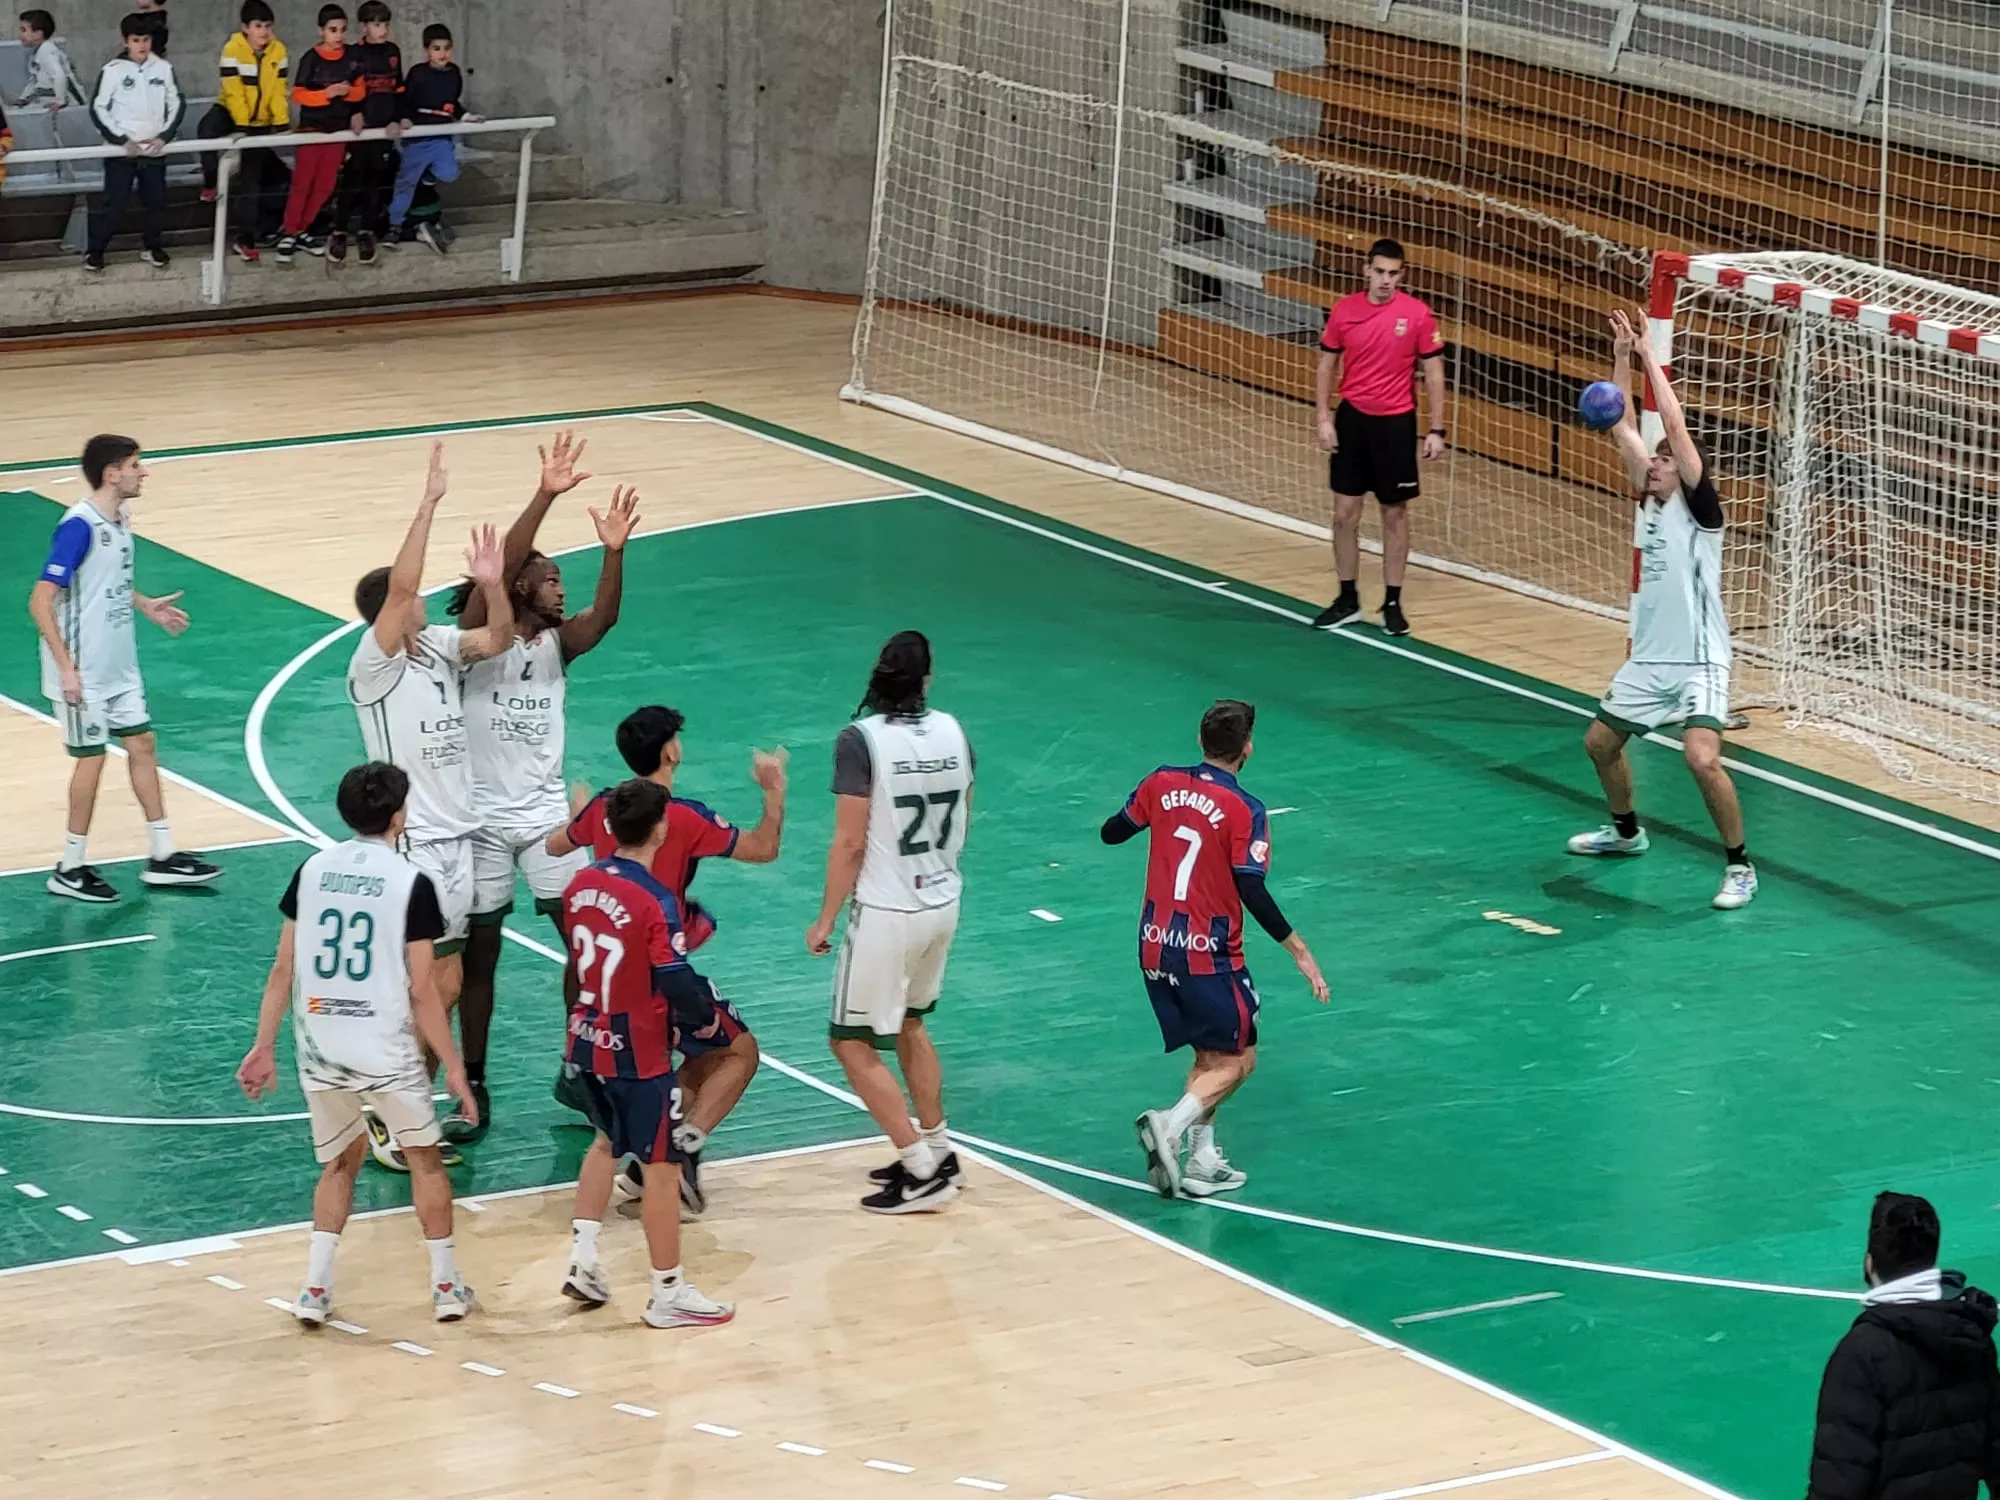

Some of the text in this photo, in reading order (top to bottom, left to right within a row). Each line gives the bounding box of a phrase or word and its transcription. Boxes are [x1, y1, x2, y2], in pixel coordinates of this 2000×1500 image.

[493, 691, 552, 711] Lobe
[893, 789, 961, 857] 27
[1172, 824, 1202, 901] 7
[314, 907, 375, 982] 33
[572, 923, 625, 1014] 27
[1141, 922, 1219, 952] SOMMOS
